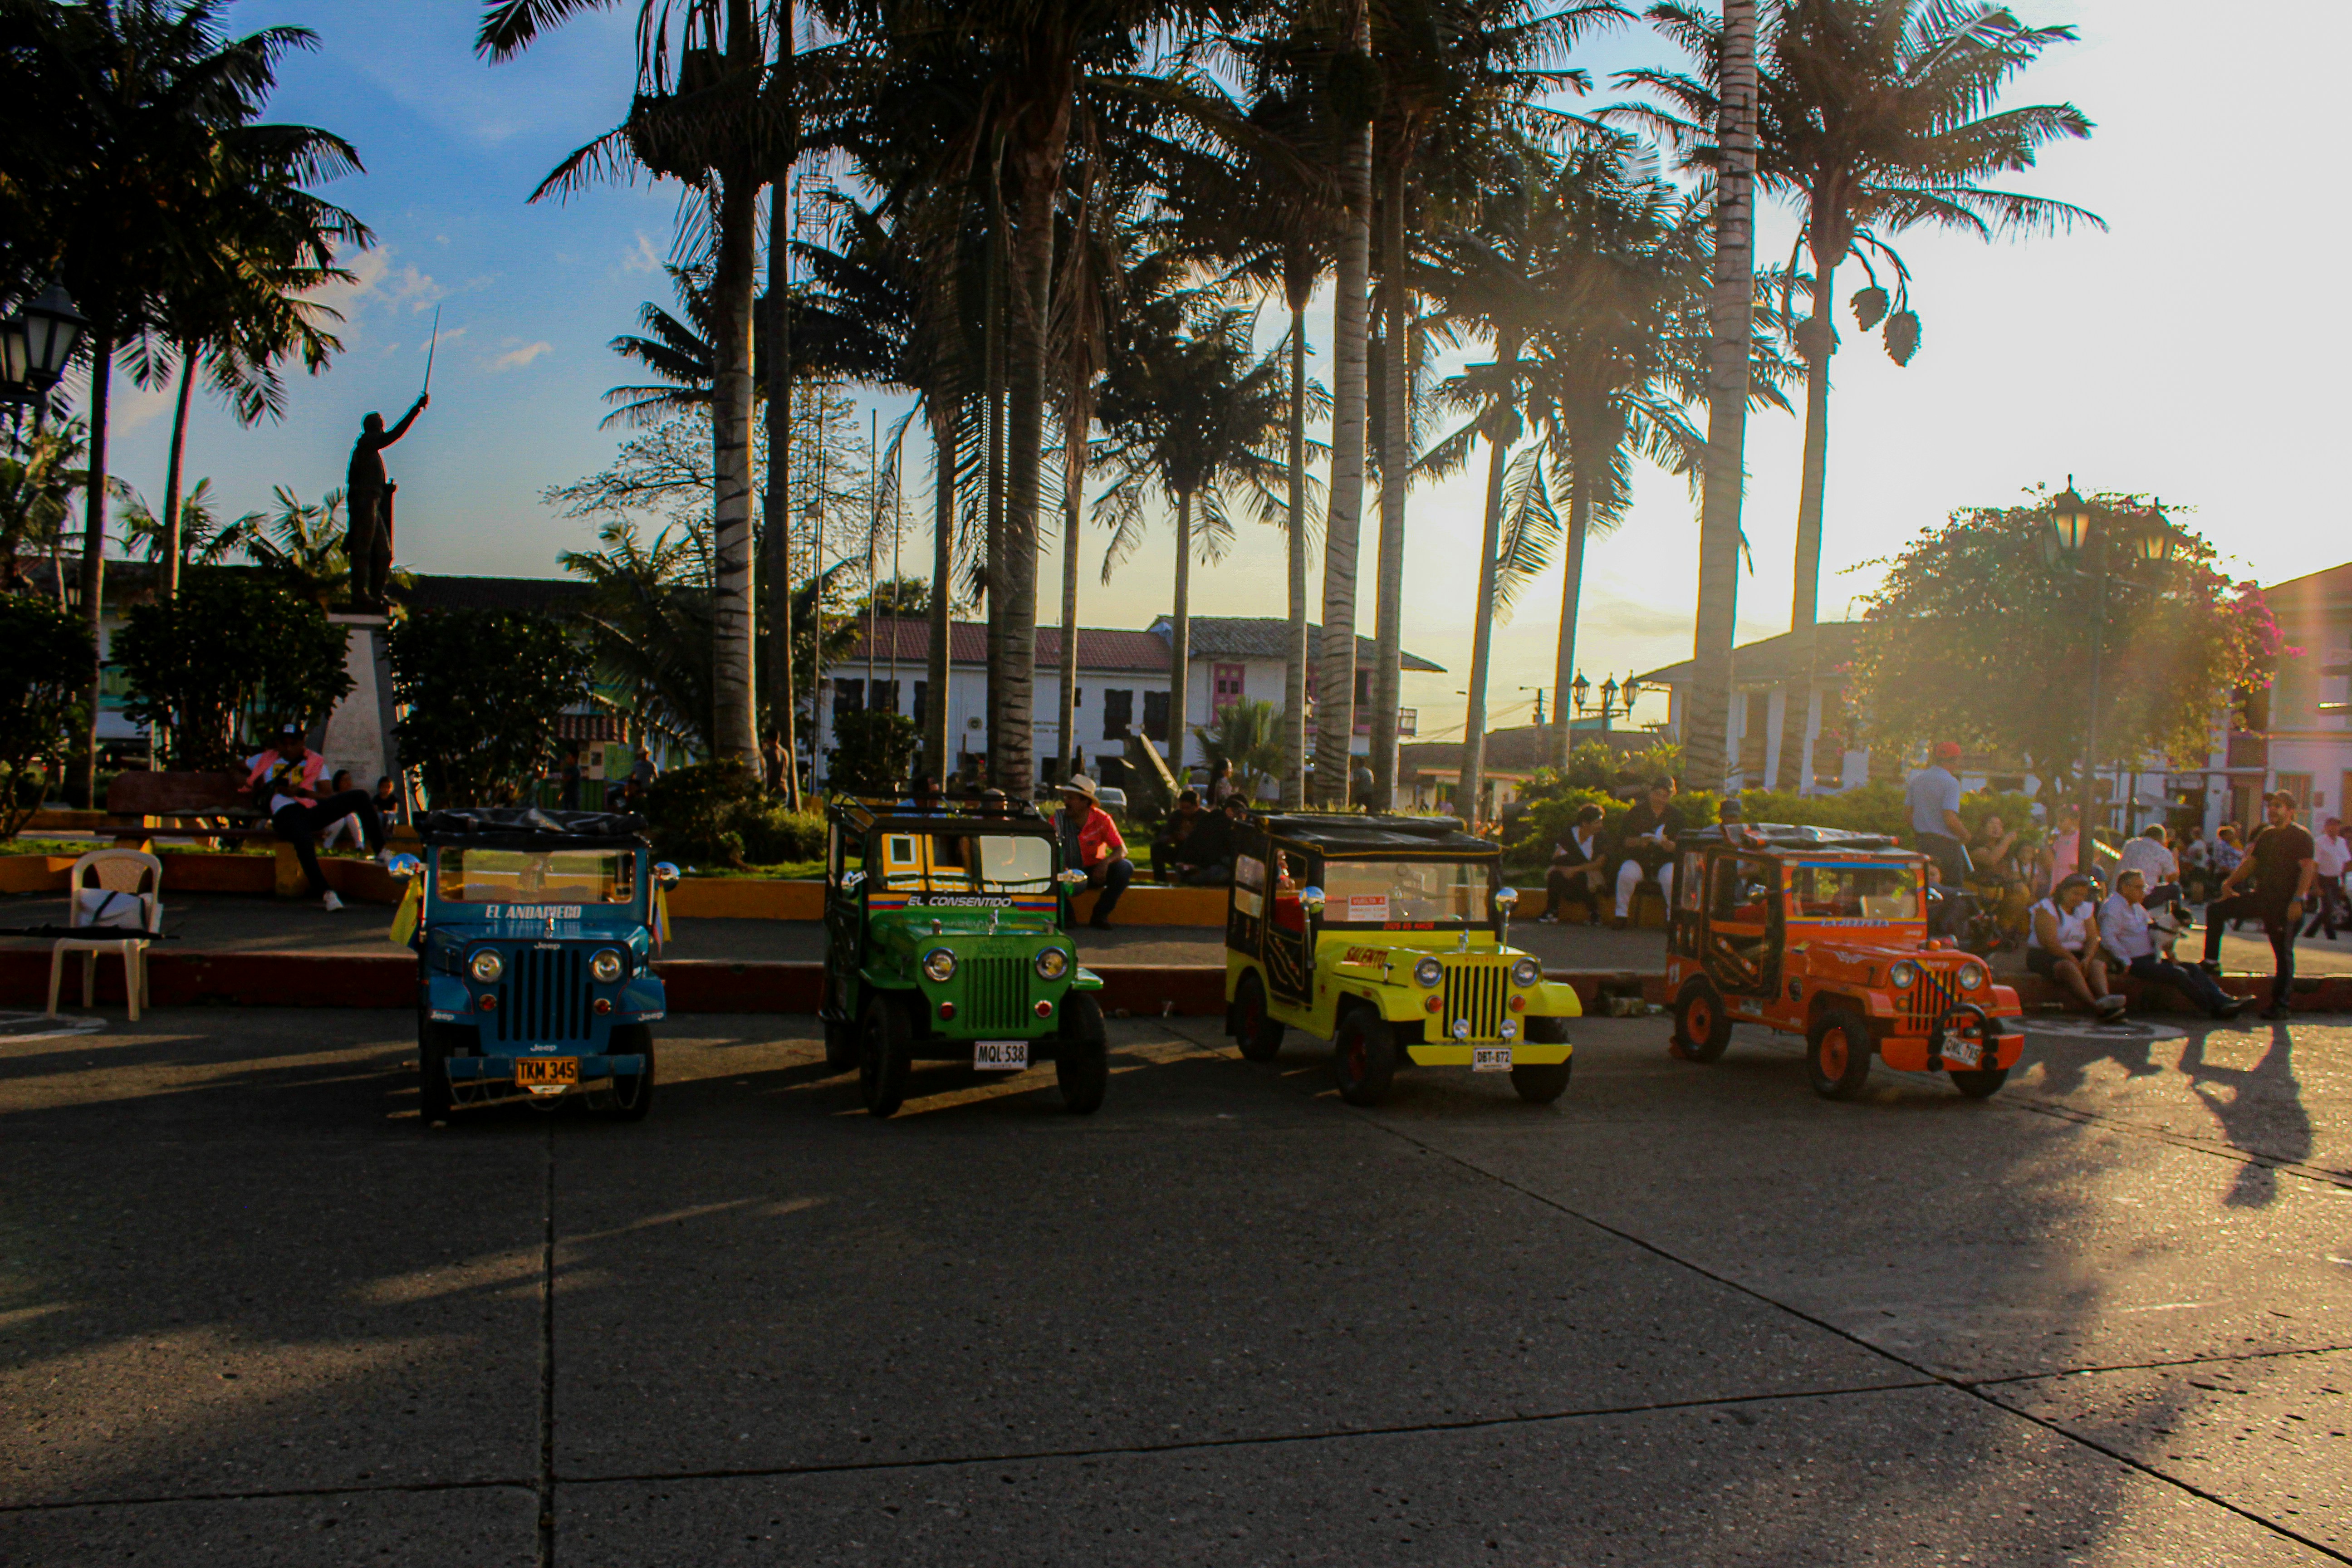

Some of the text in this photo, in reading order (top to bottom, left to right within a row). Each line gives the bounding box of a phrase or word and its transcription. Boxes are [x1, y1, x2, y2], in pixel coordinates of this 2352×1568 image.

[907, 896, 1012, 907] EL CONSENTIDO
[485, 905, 581, 919] EL ANDARIEGO
[534, 941, 560, 950] Jeep
[1344, 946, 1389, 970] SALENTO
[431, 1011, 454, 1021] Jeep
[638, 1012, 664, 1021] Jeep
[520, 1062, 574, 1079] TKM 345
